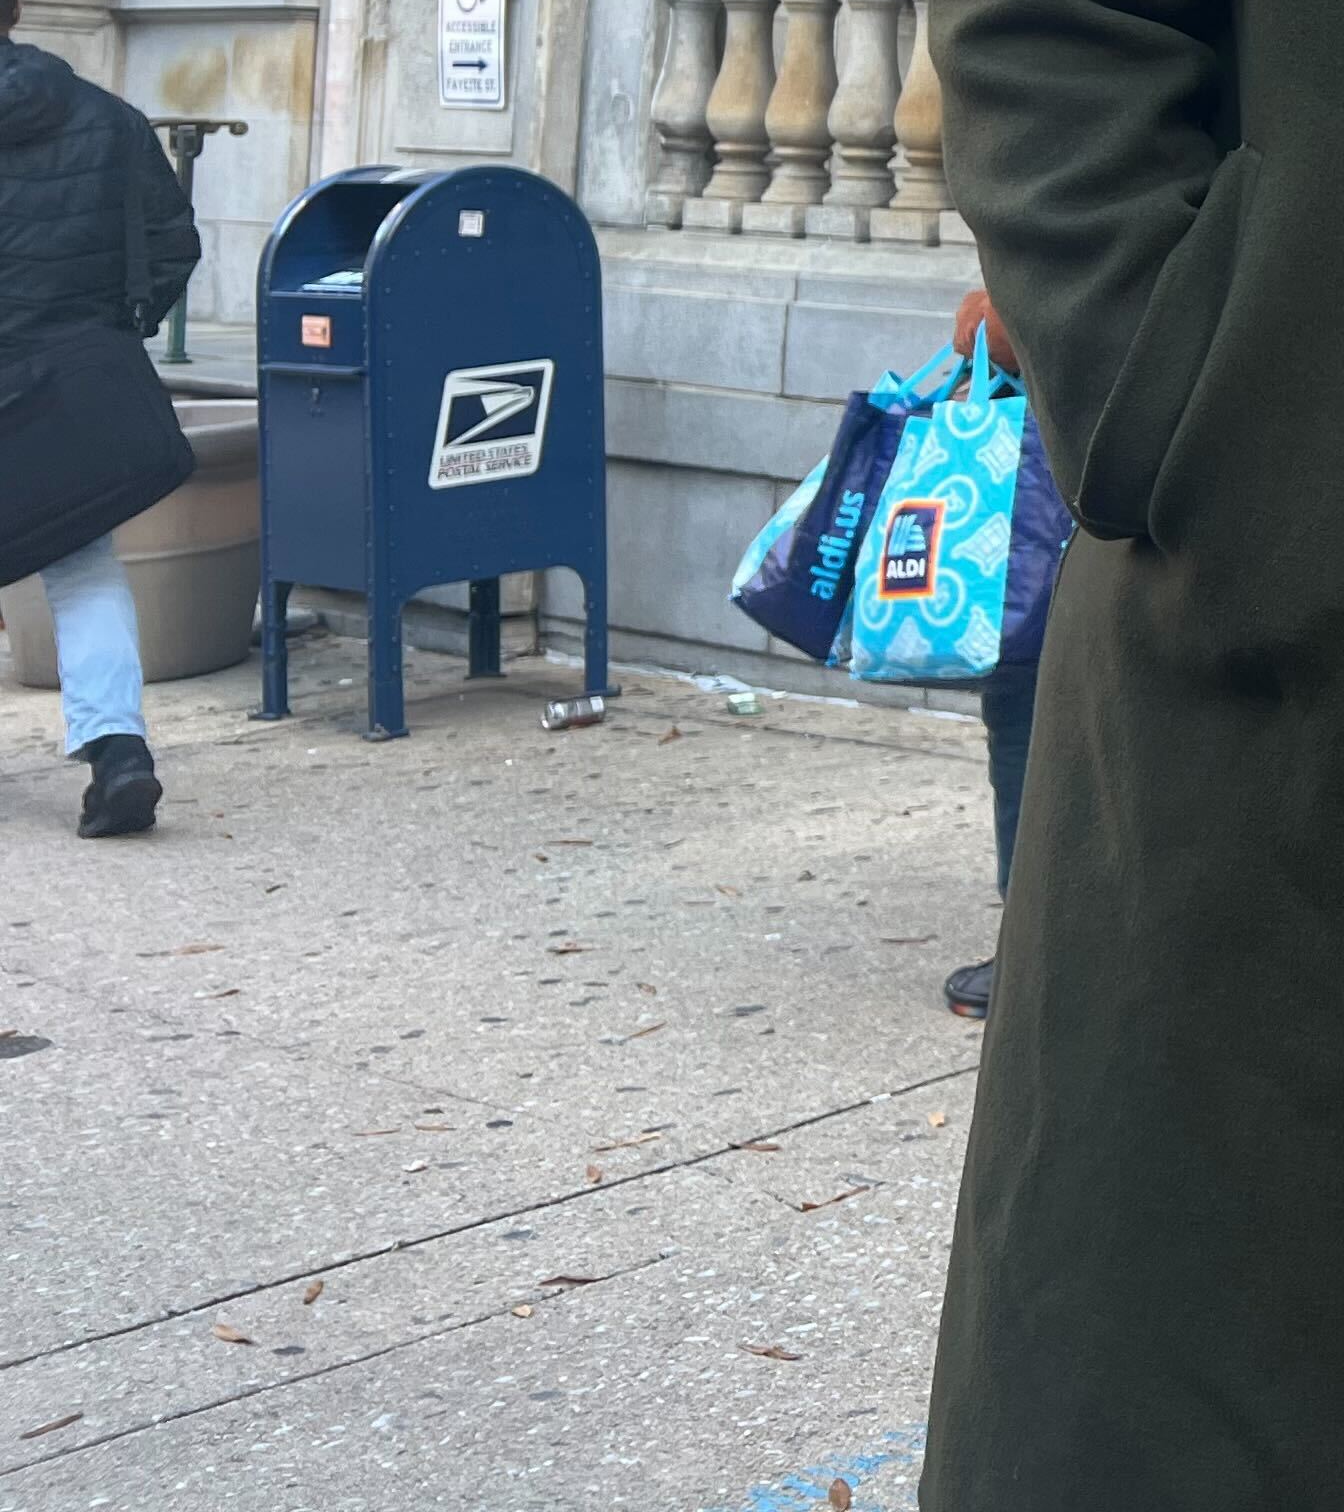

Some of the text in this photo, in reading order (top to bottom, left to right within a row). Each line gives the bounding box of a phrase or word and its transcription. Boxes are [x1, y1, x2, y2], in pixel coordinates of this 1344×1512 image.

[445, 20, 496, 34] ACCESSIBLE
[449, 40, 493, 54] ENTRANCE
[446, 78, 483, 93] FAYETTE
[440, 442, 529, 466] UNITED STATES
[437, 463, 481, 480] POSTAL
[809, 488, 865, 602] aldi.us
[886, 559, 926, 579] ALDI
